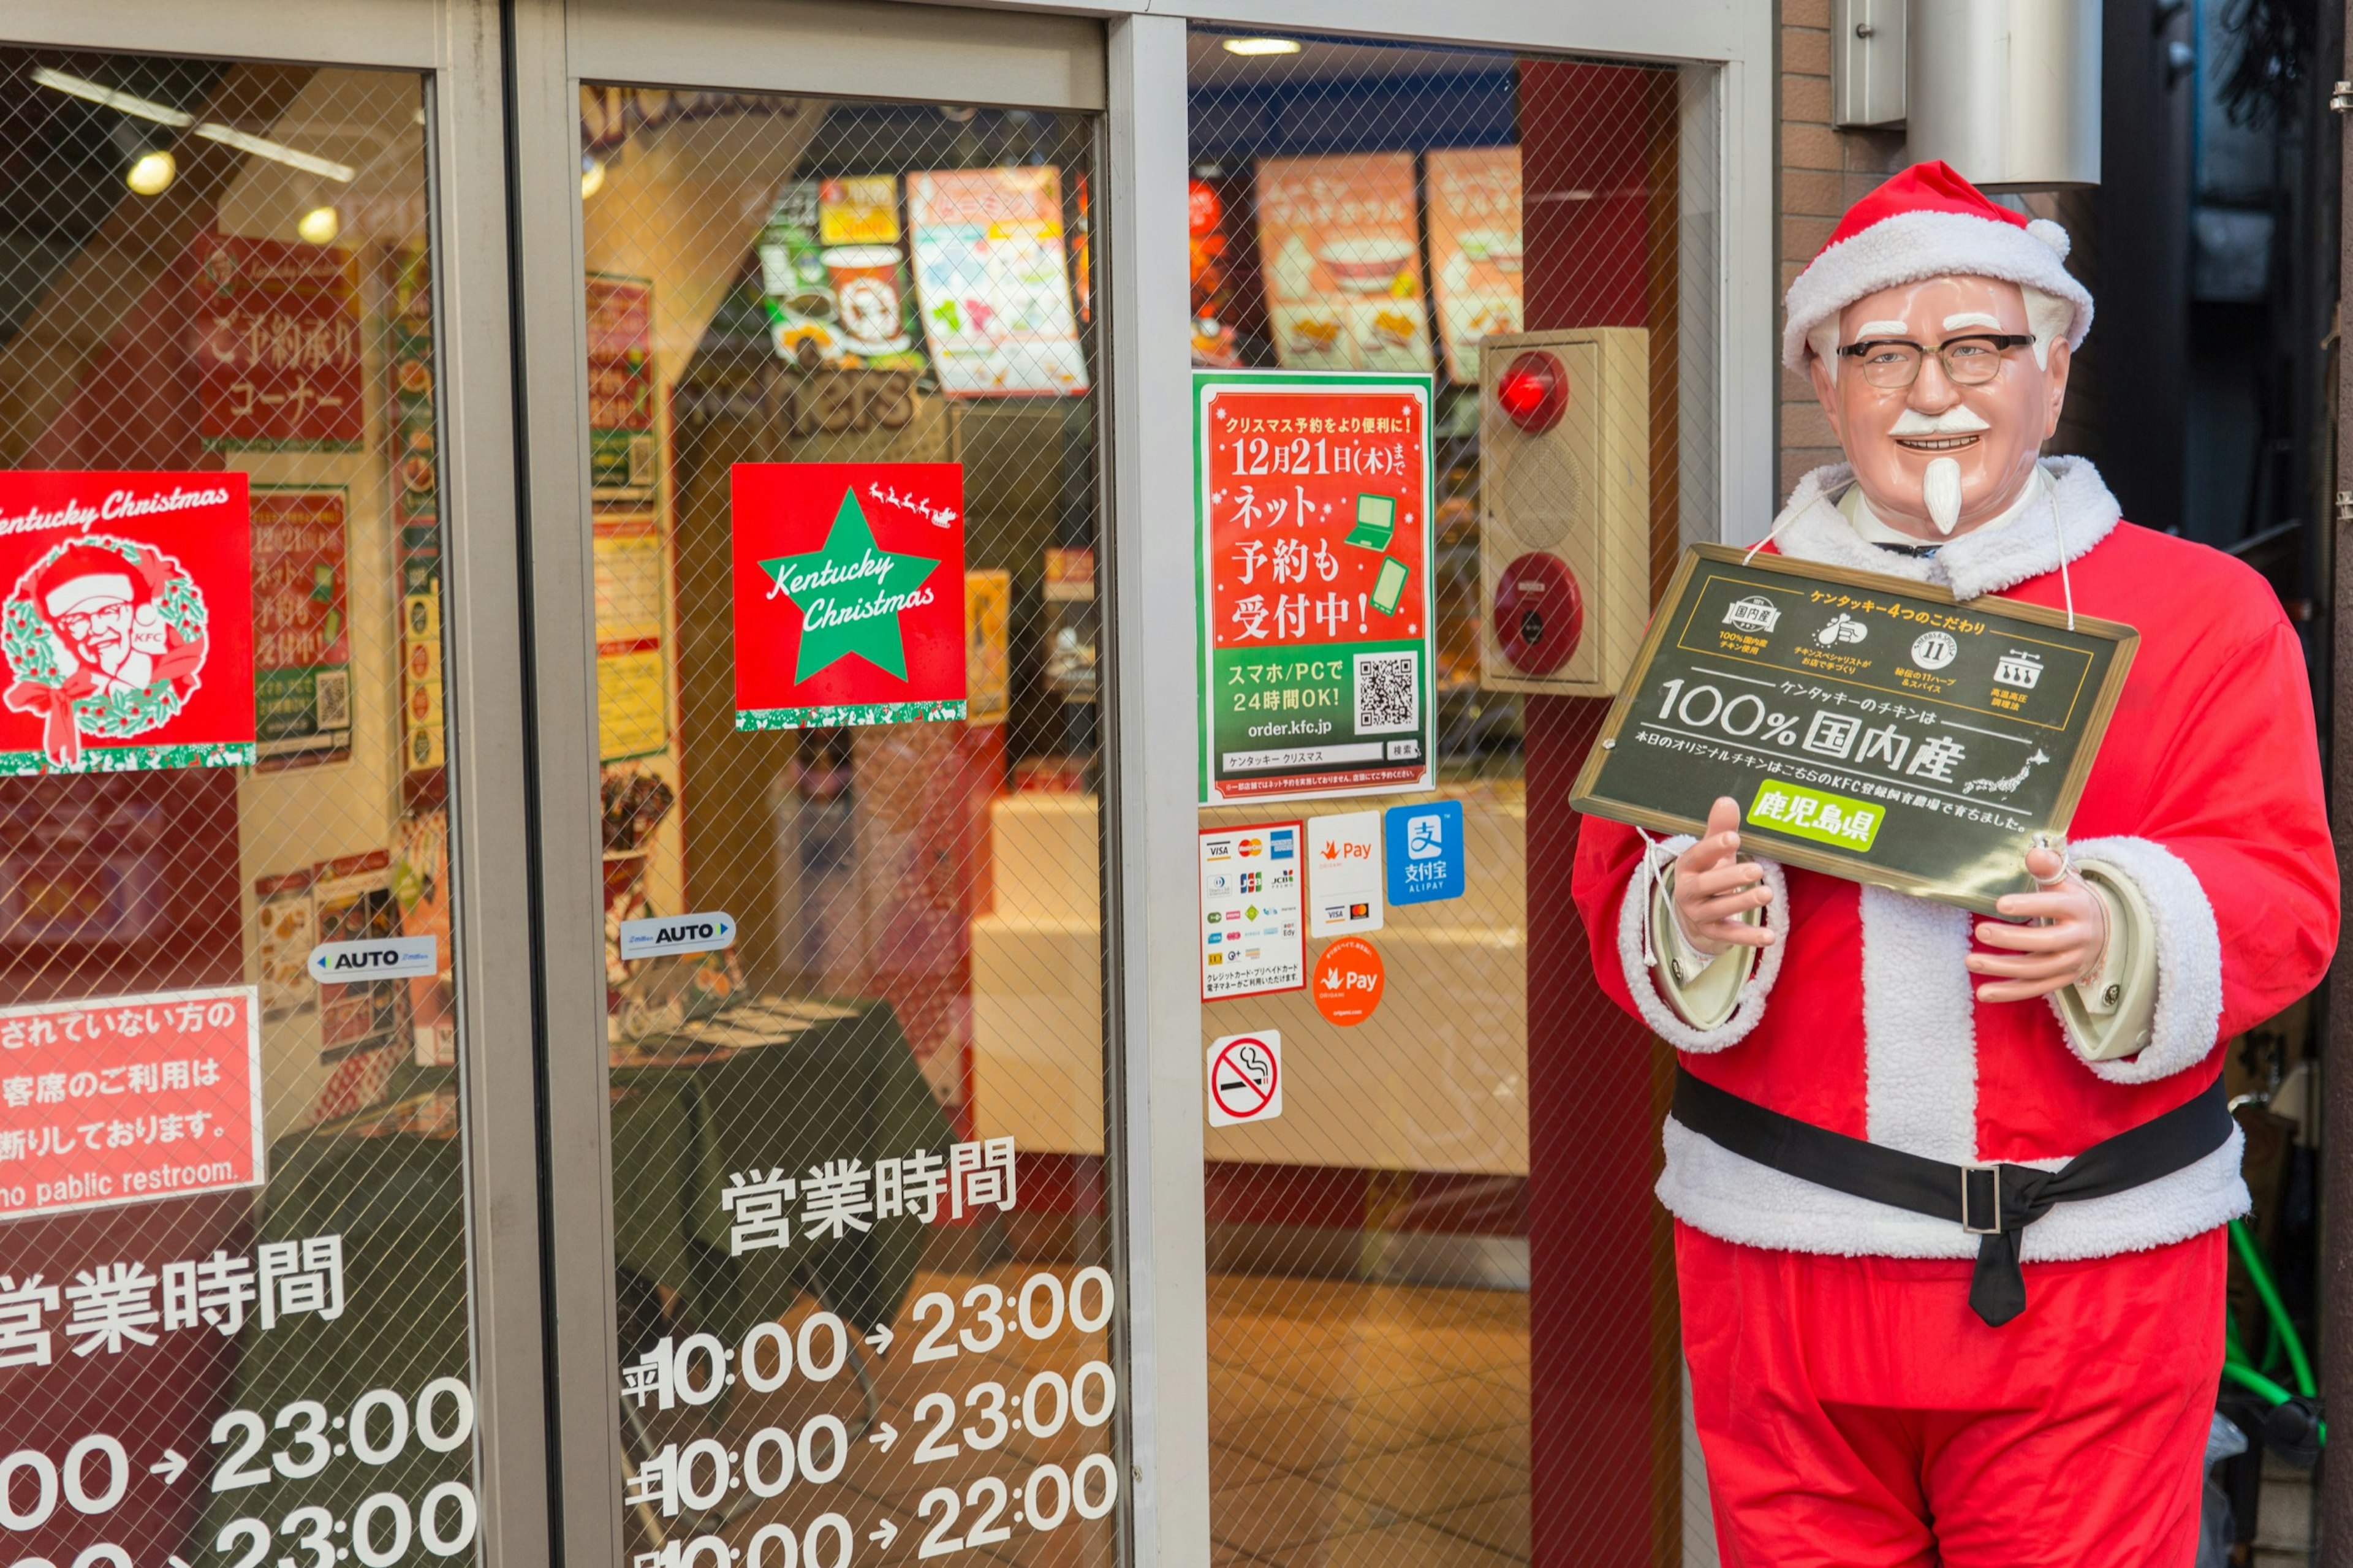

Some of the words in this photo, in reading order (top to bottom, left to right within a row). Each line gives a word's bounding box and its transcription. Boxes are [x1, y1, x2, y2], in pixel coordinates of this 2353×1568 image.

[230, 374, 344, 424] コーナー
[0, 498, 99, 536] entucky
[100, 485, 229, 520] Christmas
[1229, 485, 1316, 529] ネット
[765, 548, 895, 600] Kentucky
[1231, 538, 1339, 585] 予約も
[801, 582, 934, 633] Christmas
[1231, 591, 1368, 642] 受付中!
[1735, 605, 1771, 623] 国内産
[1810, 590, 1985, 635] ケンタッキー4つのこだわり
[134, 633, 162, 643] KFC
[1719, 631, 1768, 648] 100%国内産
[1923, 641, 1944, 661] 11
[1227, 660, 1344, 686] スマホ/PCで
[1233, 687, 1339, 712] 24時間OK!
[1780, 680, 1938, 724] ケンタッキーのチキンは
[1248, 718, 1333, 738] order.kfc.jp
[1658, 678, 1966, 784] 100%国内産
[1283, 751, 1324, 764] クリスマス
[1753, 790, 1876, 843] 鹿児島県
[1210, 846, 1229, 856] VISA
[1343, 843, 1372, 860] Pay
[1404, 860, 1447, 884] 支付宝
[1409, 881, 1444, 893] ALIPAY
[655, 923, 714, 944] AUTO
[1328, 911, 1344, 919] VISA
[334, 950, 399, 970] AUTO
[1346, 971, 1378, 993] Pay
[1, 1001, 236, 1049] されていない方の
[2, 1058, 221, 1108] 客席のご利用は
[0, 1110, 225, 1161] 断りしております。
[36, 1172, 112, 1205] pablic
[122, 1161, 239, 1193] restroom.
[721, 1135, 1017, 1257] 営業時間
[0, 1233, 345, 1368] 営業時間
[640, 1311, 847, 1411] 10:00
[911, 1265, 1115, 1364] 23:00
[210, 1376, 474, 1493] 23:00
[640, 1413, 849, 1517] 10:00
[912, 1360, 1116, 1465] 23:00
[216, 1481, 479, 1568] 23:00
[917, 1453, 1119, 1560] 22:00
